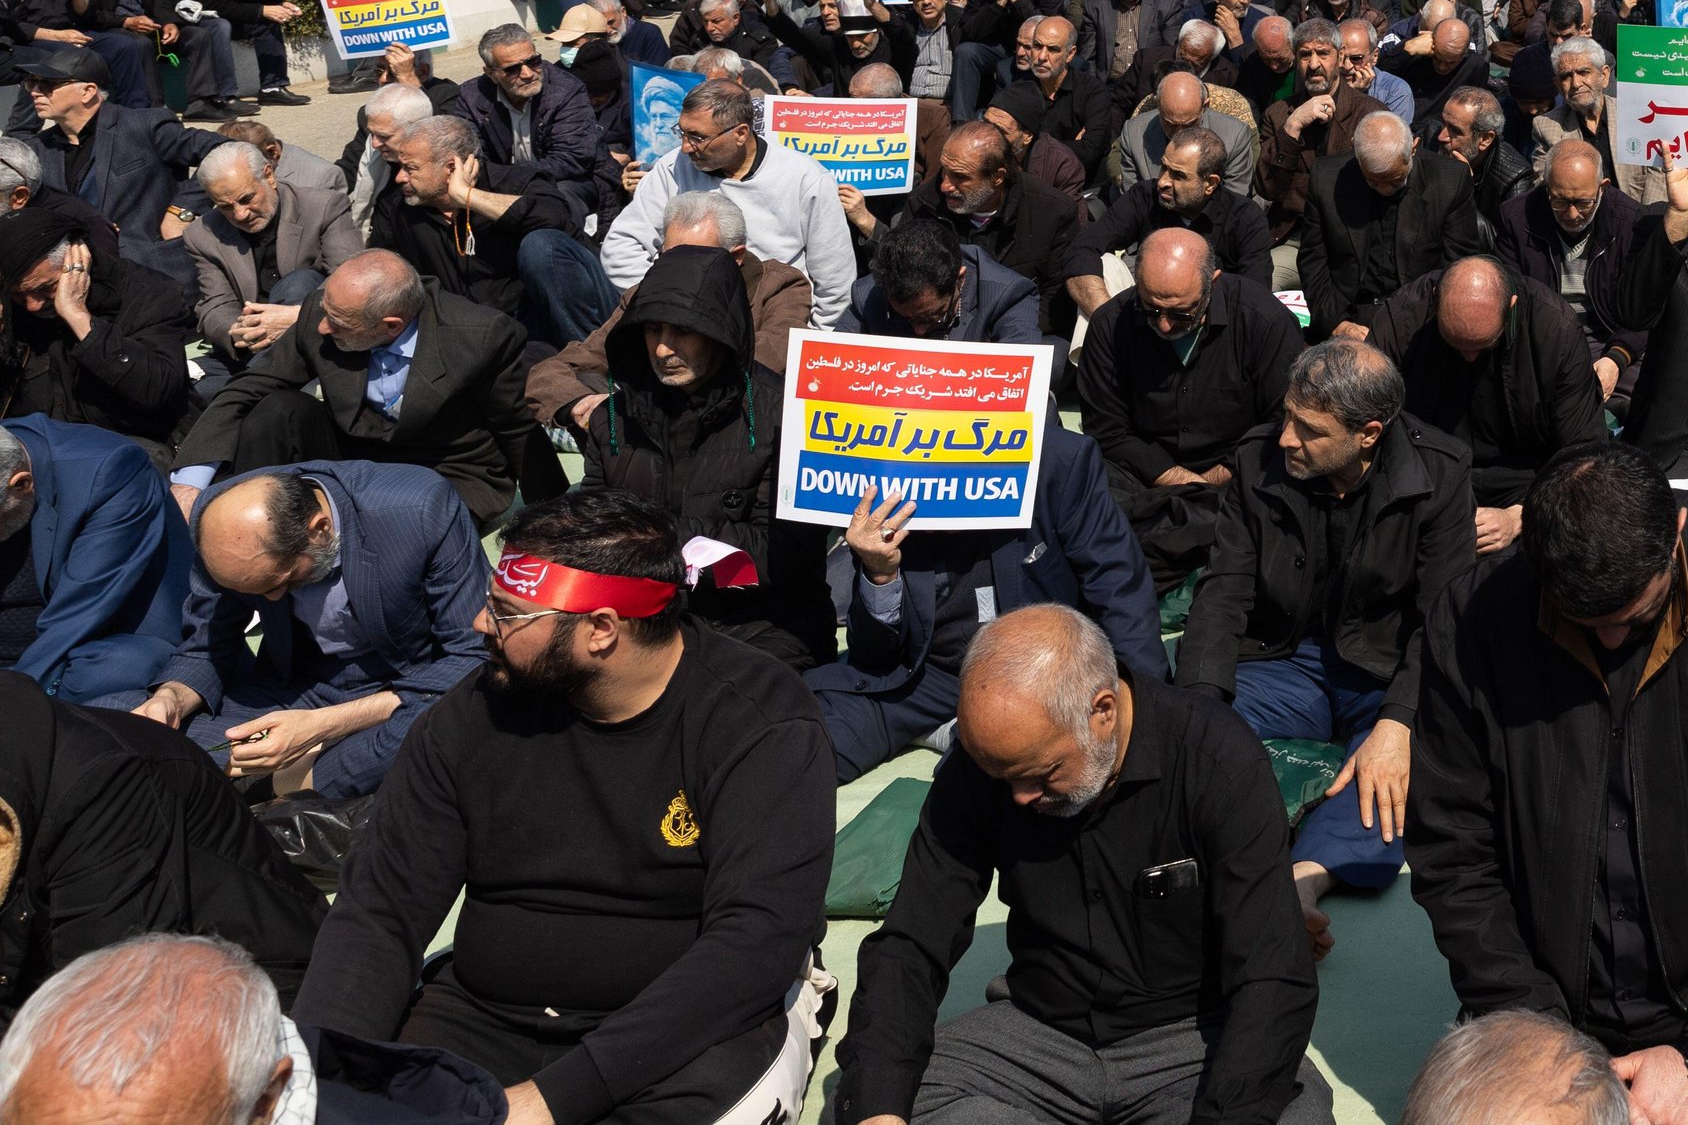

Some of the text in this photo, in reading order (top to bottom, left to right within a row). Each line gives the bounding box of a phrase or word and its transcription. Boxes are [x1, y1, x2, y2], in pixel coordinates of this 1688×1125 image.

[339, 0, 439, 27] مرگ بر آمریکا
[343, 21, 446, 47] DOWN WITH USA
[1631, 50, 1667, 59] نیست
[1662, 67, 1686, 77] است
[777, 108, 800, 117] فلسطین
[808, 110, 824, 118] امروز
[823, 109, 833, 117] که
[832, 111, 856, 119] جنایاتی
[871, 111, 880, 119] در
[878, 109, 905, 119] آمریکا
[840, 121, 866, 130] شریک
[878, 122, 889, 130] می
[889, 120, 904, 129] اتفاق
[783, 135, 907, 160] مرگ بر آمریکا
[831, 166, 905, 182] WITH USA
[806, 356, 1029, 380] آمریکا در همه جنایاتی که امروز در فلسطین
[874, 382, 903, 395] جرم
[905, 384, 952, 398] شریک
[954, 386, 976, 398] افتد
[997, 387, 1024, 399] اتفاق
[977, 388, 995, 402] می
[809, 410, 1028, 457] مرگ بر آمریکا
[800, 467, 877, 497] DOWN
[880, 476, 958, 501] WITH
[964, 477, 1019, 501] USA
[1265, 745, 1336, 779] نماز جمعه تهران
